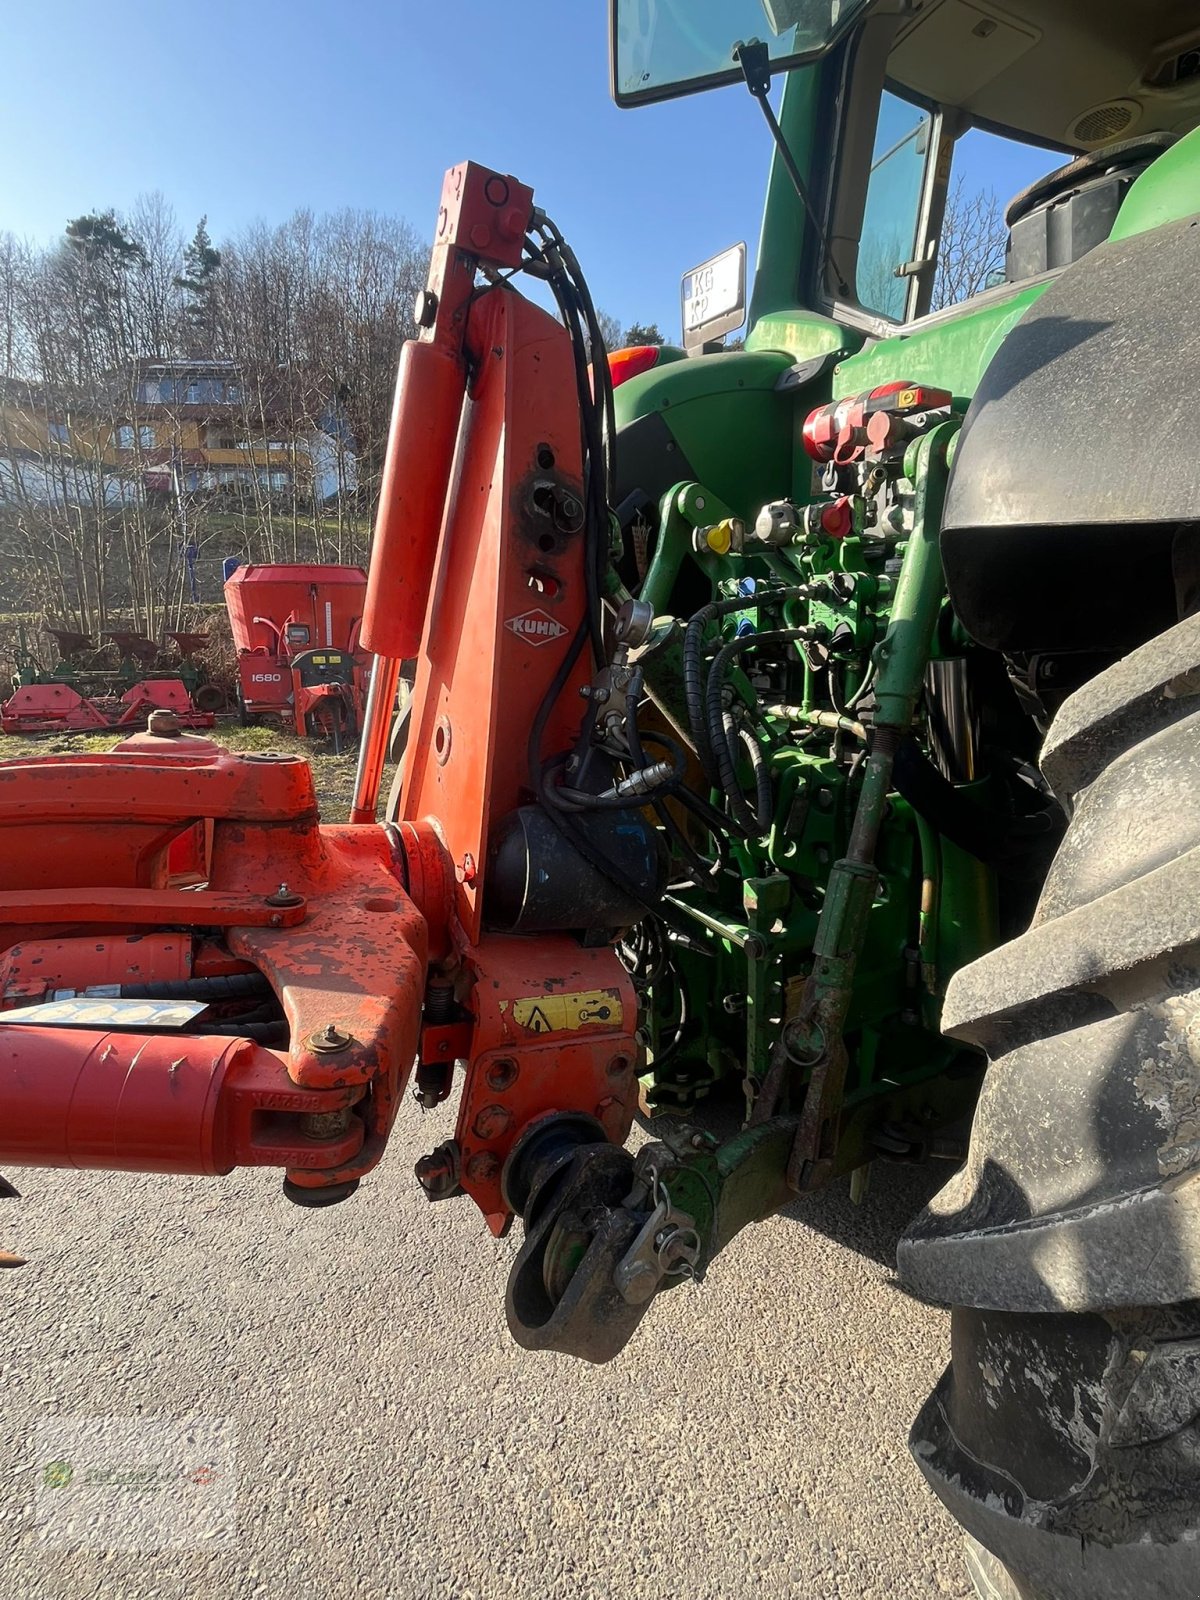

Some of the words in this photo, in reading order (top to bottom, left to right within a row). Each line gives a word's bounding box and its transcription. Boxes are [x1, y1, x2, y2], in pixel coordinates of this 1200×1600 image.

[694, 267, 714, 297] KG
[691, 295, 709, 324] KP
[512, 617, 561, 636] KUHN
[252, 673, 281, 682] 1680
